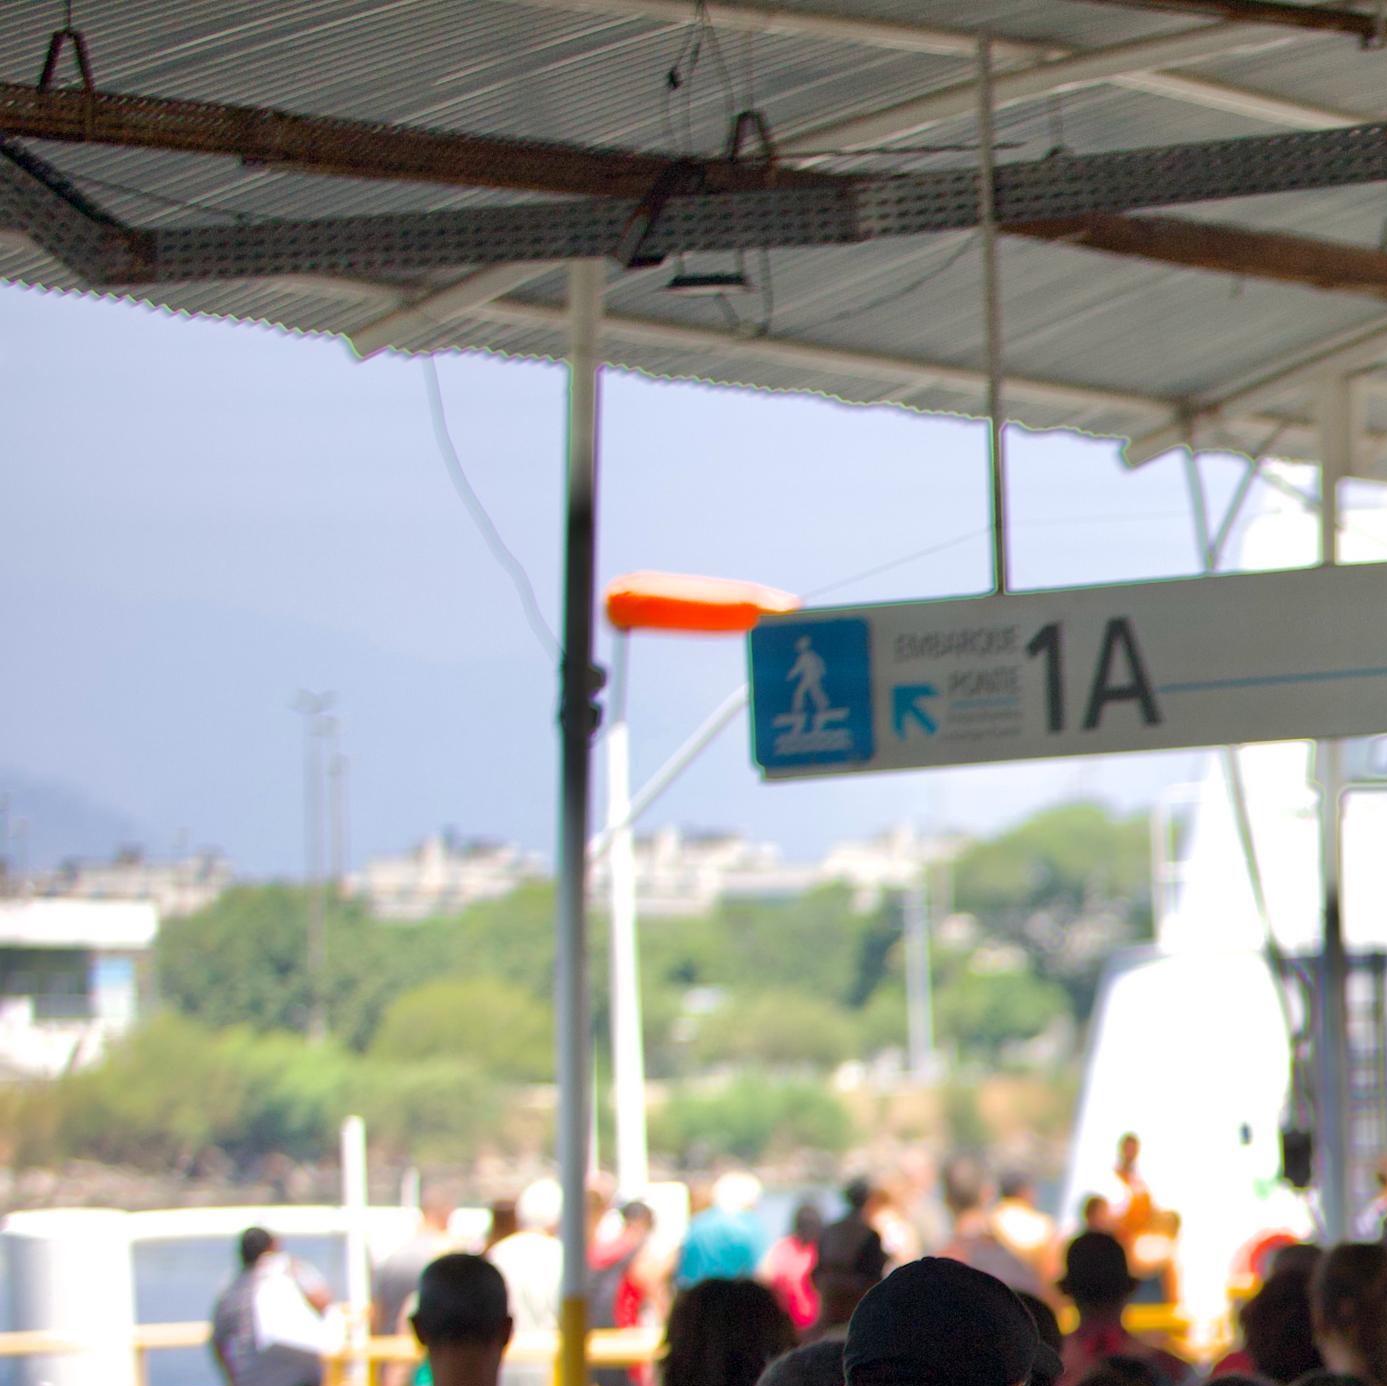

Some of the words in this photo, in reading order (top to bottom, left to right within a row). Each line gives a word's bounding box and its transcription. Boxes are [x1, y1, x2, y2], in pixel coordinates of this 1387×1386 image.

[895, 625, 1020, 661] EMBARQUE
[1025, 614, 1163, 733] 1A
[907, 811, 967, 829] Unimed
